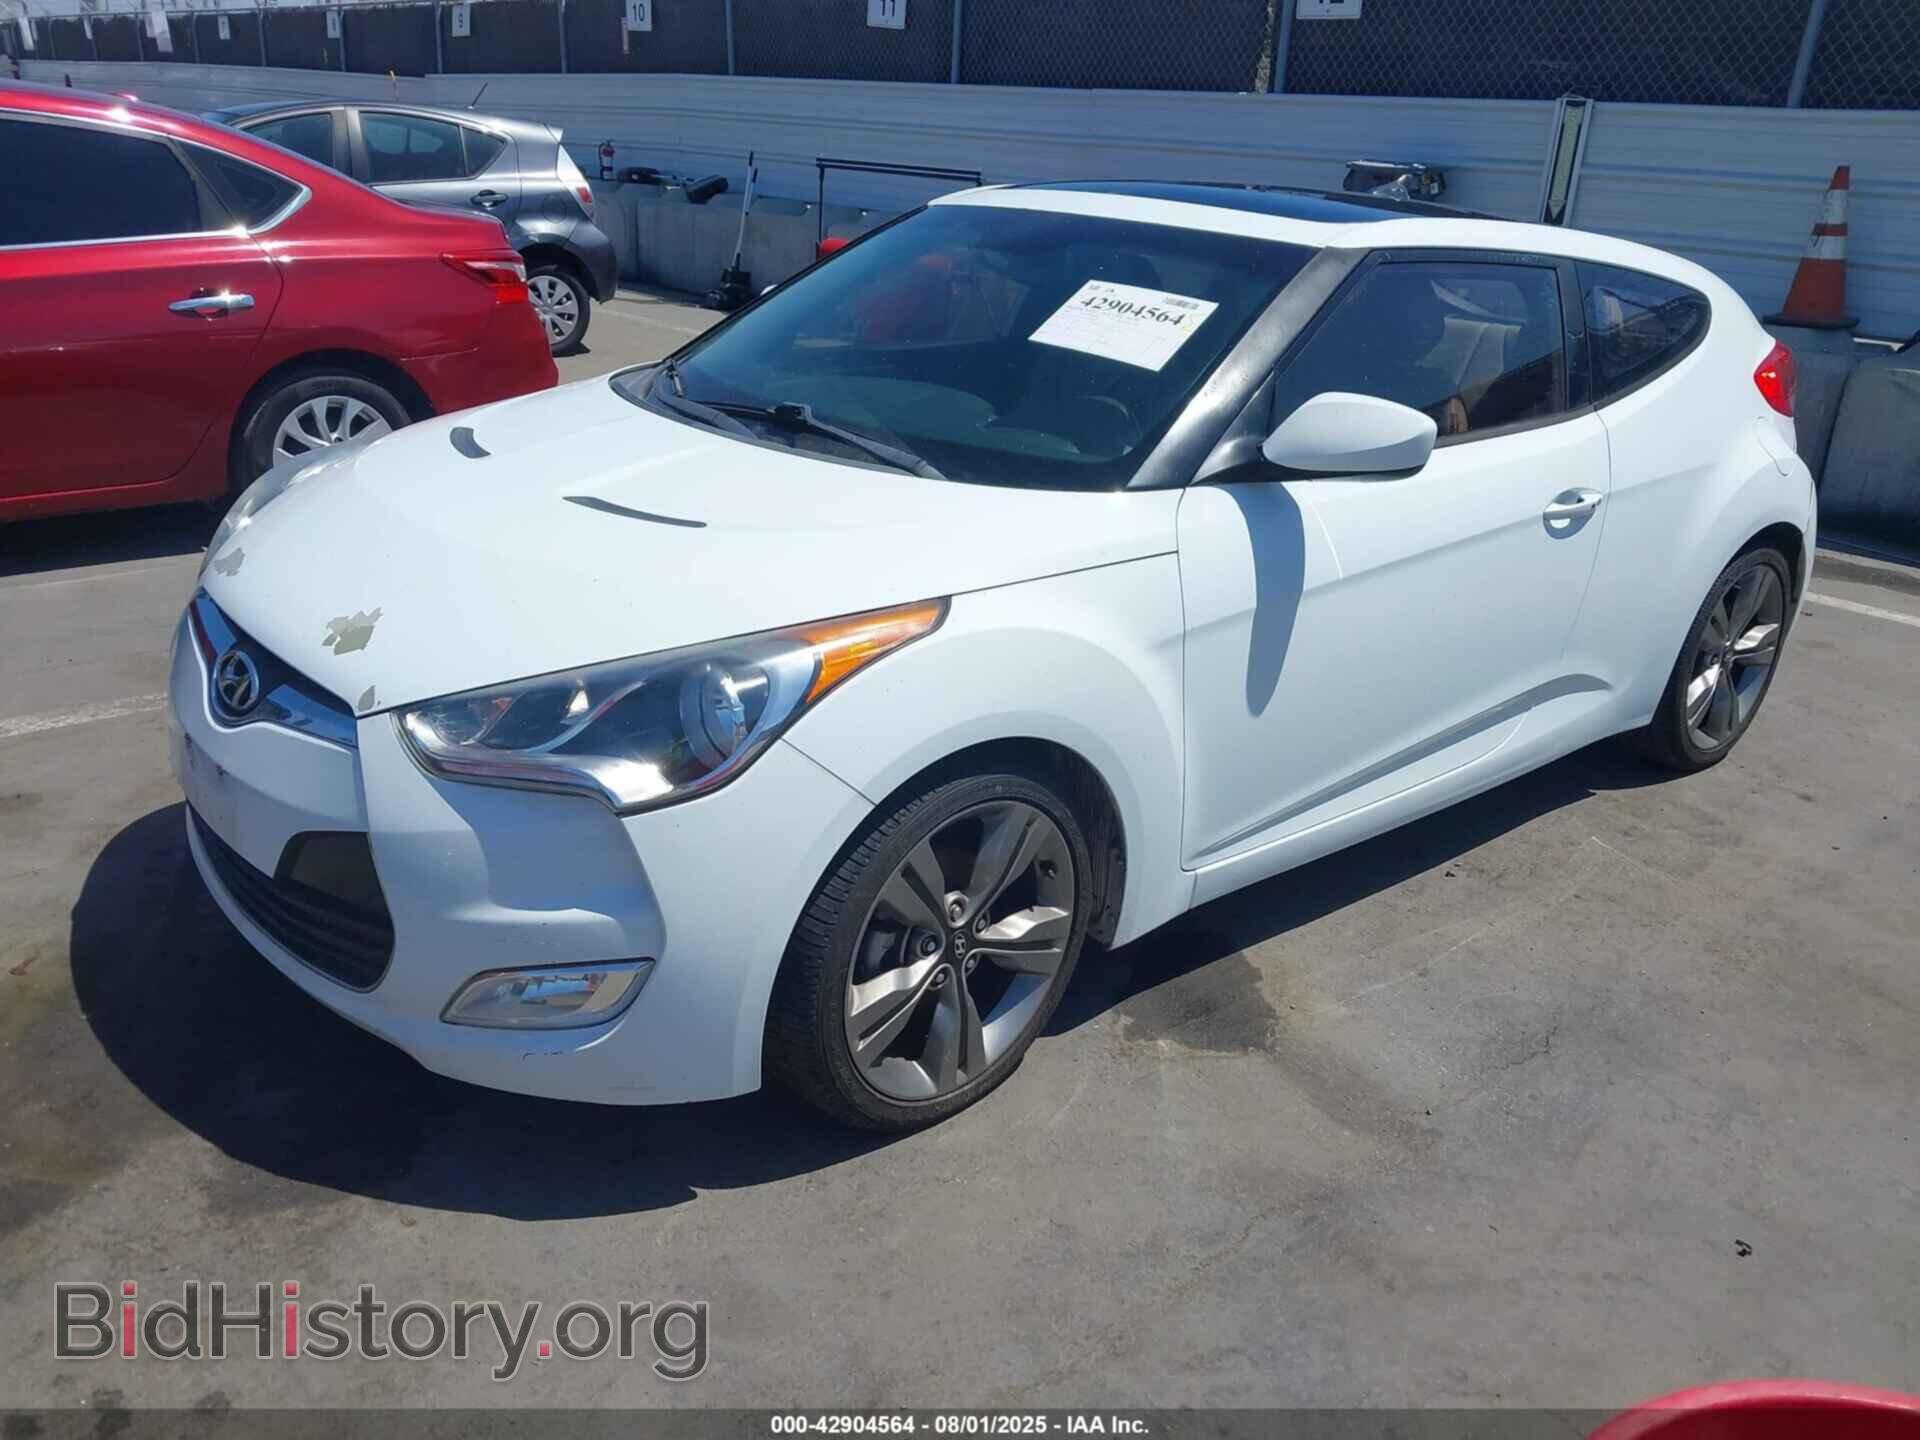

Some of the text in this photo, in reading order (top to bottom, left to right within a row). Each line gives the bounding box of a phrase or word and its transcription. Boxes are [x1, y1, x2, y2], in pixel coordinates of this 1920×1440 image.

[633, 3, 645, 22] 10
[882, 0, 895, 16] 11
[1081, 296, 1186, 326] 42904564
